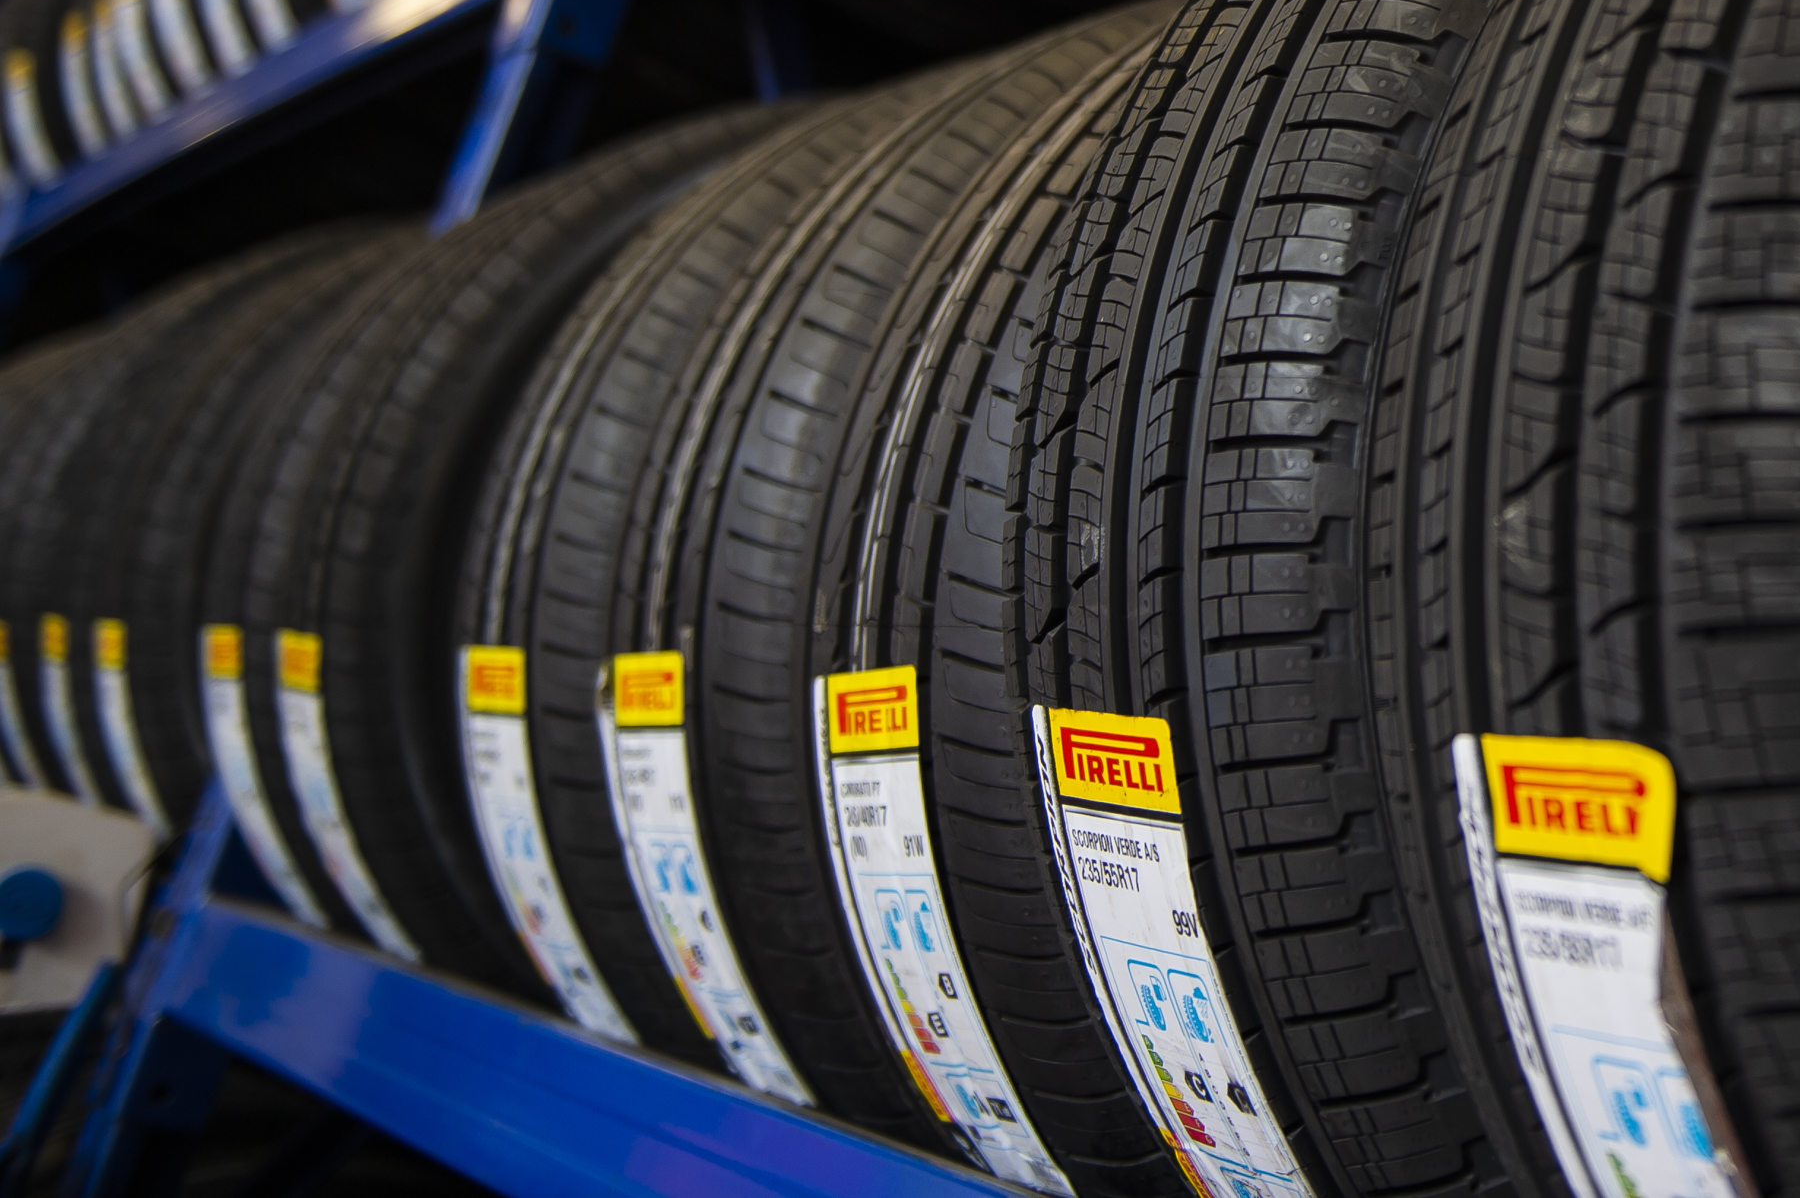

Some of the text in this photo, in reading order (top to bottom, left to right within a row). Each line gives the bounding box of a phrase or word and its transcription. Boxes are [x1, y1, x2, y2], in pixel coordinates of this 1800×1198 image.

[836, 685, 909, 737] PIRELLI
[1060, 727, 1164, 793] PIRELLI
[1072, 829, 1160, 863] SCORPION VERDE A/S
[1078, 856, 1140, 893] 235/55R17
[1172, 910, 1198, 939] 99V
[932, 1014, 945, 1036] E
[1192, 1074, 1206, 1097] C
